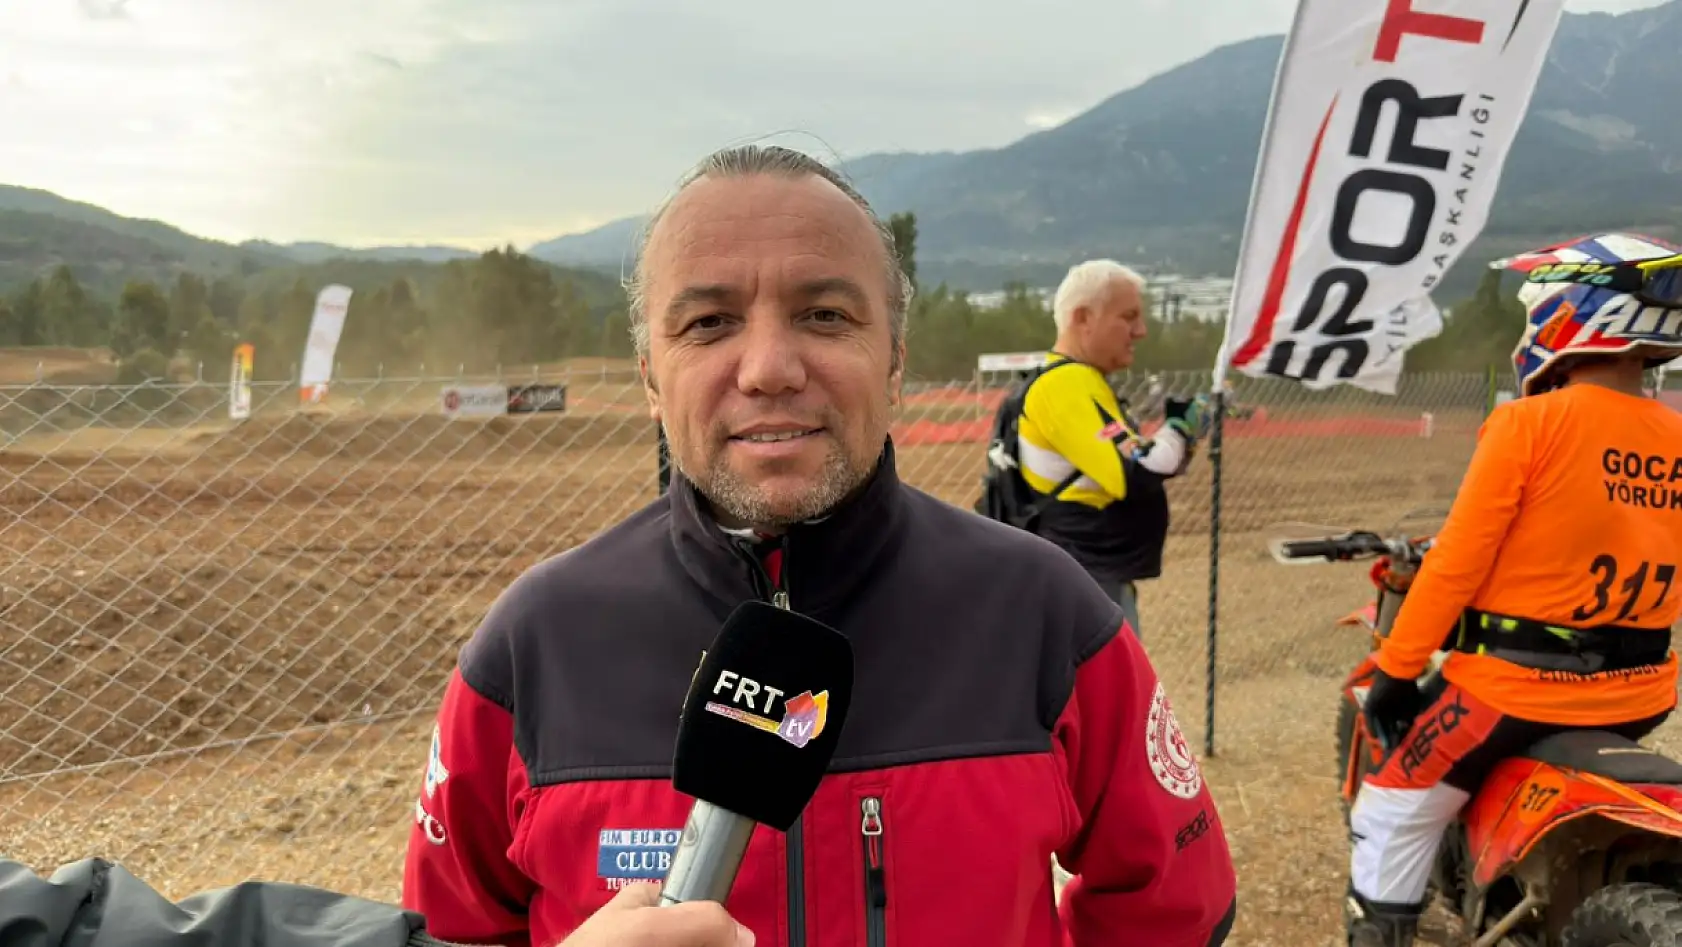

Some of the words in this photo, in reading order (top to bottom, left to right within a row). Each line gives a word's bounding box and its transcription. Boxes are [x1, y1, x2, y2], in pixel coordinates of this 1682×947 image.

[1420, 94, 1496, 288] BAŞKANLIĞI
[1571, 553, 1676, 622] 317
[713, 669, 784, 714] FRT
[785, 719, 813, 738] tv
[1522, 782, 1560, 812] 317
[630, 831, 678, 844] EURO
[616, 851, 671, 871] CLUB
